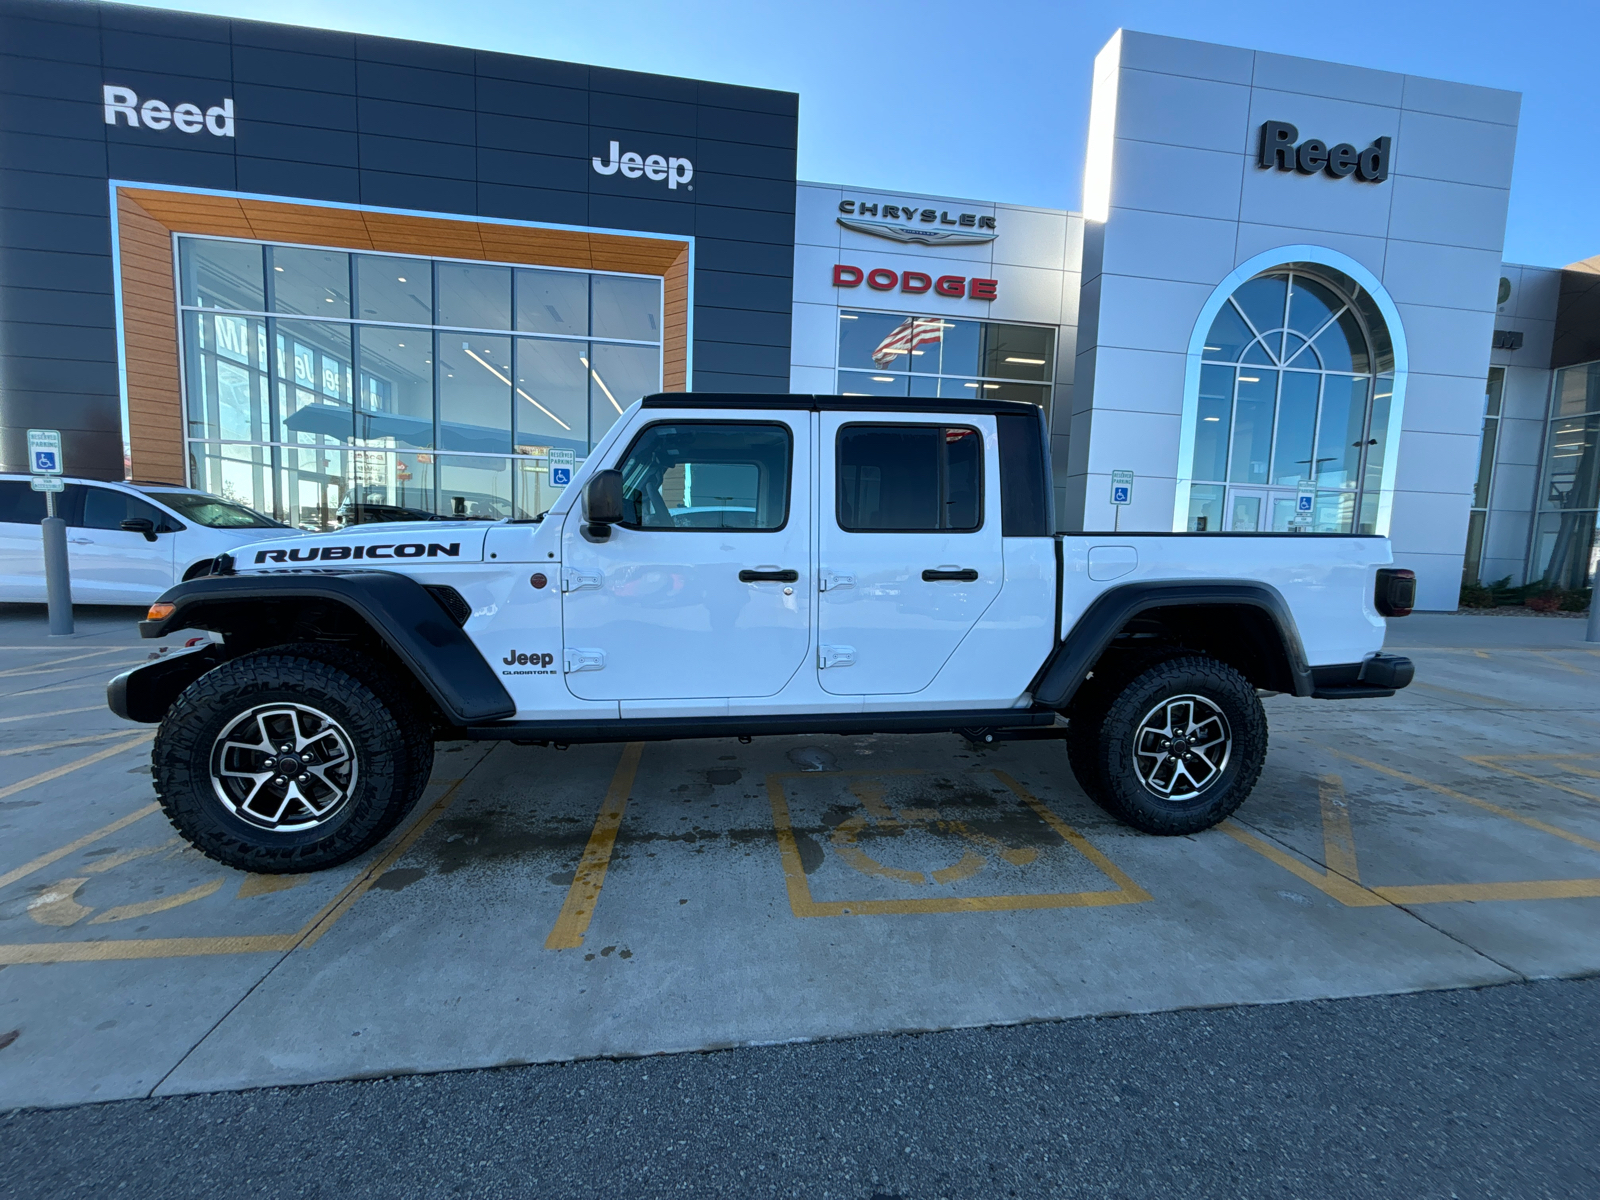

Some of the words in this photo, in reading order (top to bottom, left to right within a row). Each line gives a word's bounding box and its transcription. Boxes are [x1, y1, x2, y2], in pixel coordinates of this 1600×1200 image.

[103, 85, 235, 137] Reed
[592, 141, 694, 189] Jeep
[1258, 120, 1392, 184] Reed
[838, 200, 997, 228] CHRYSLER
[833, 264, 998, 301] DODGE
[254, 543, 461, 564] RUBICON
[503, 650, 553, 668] Jeep
